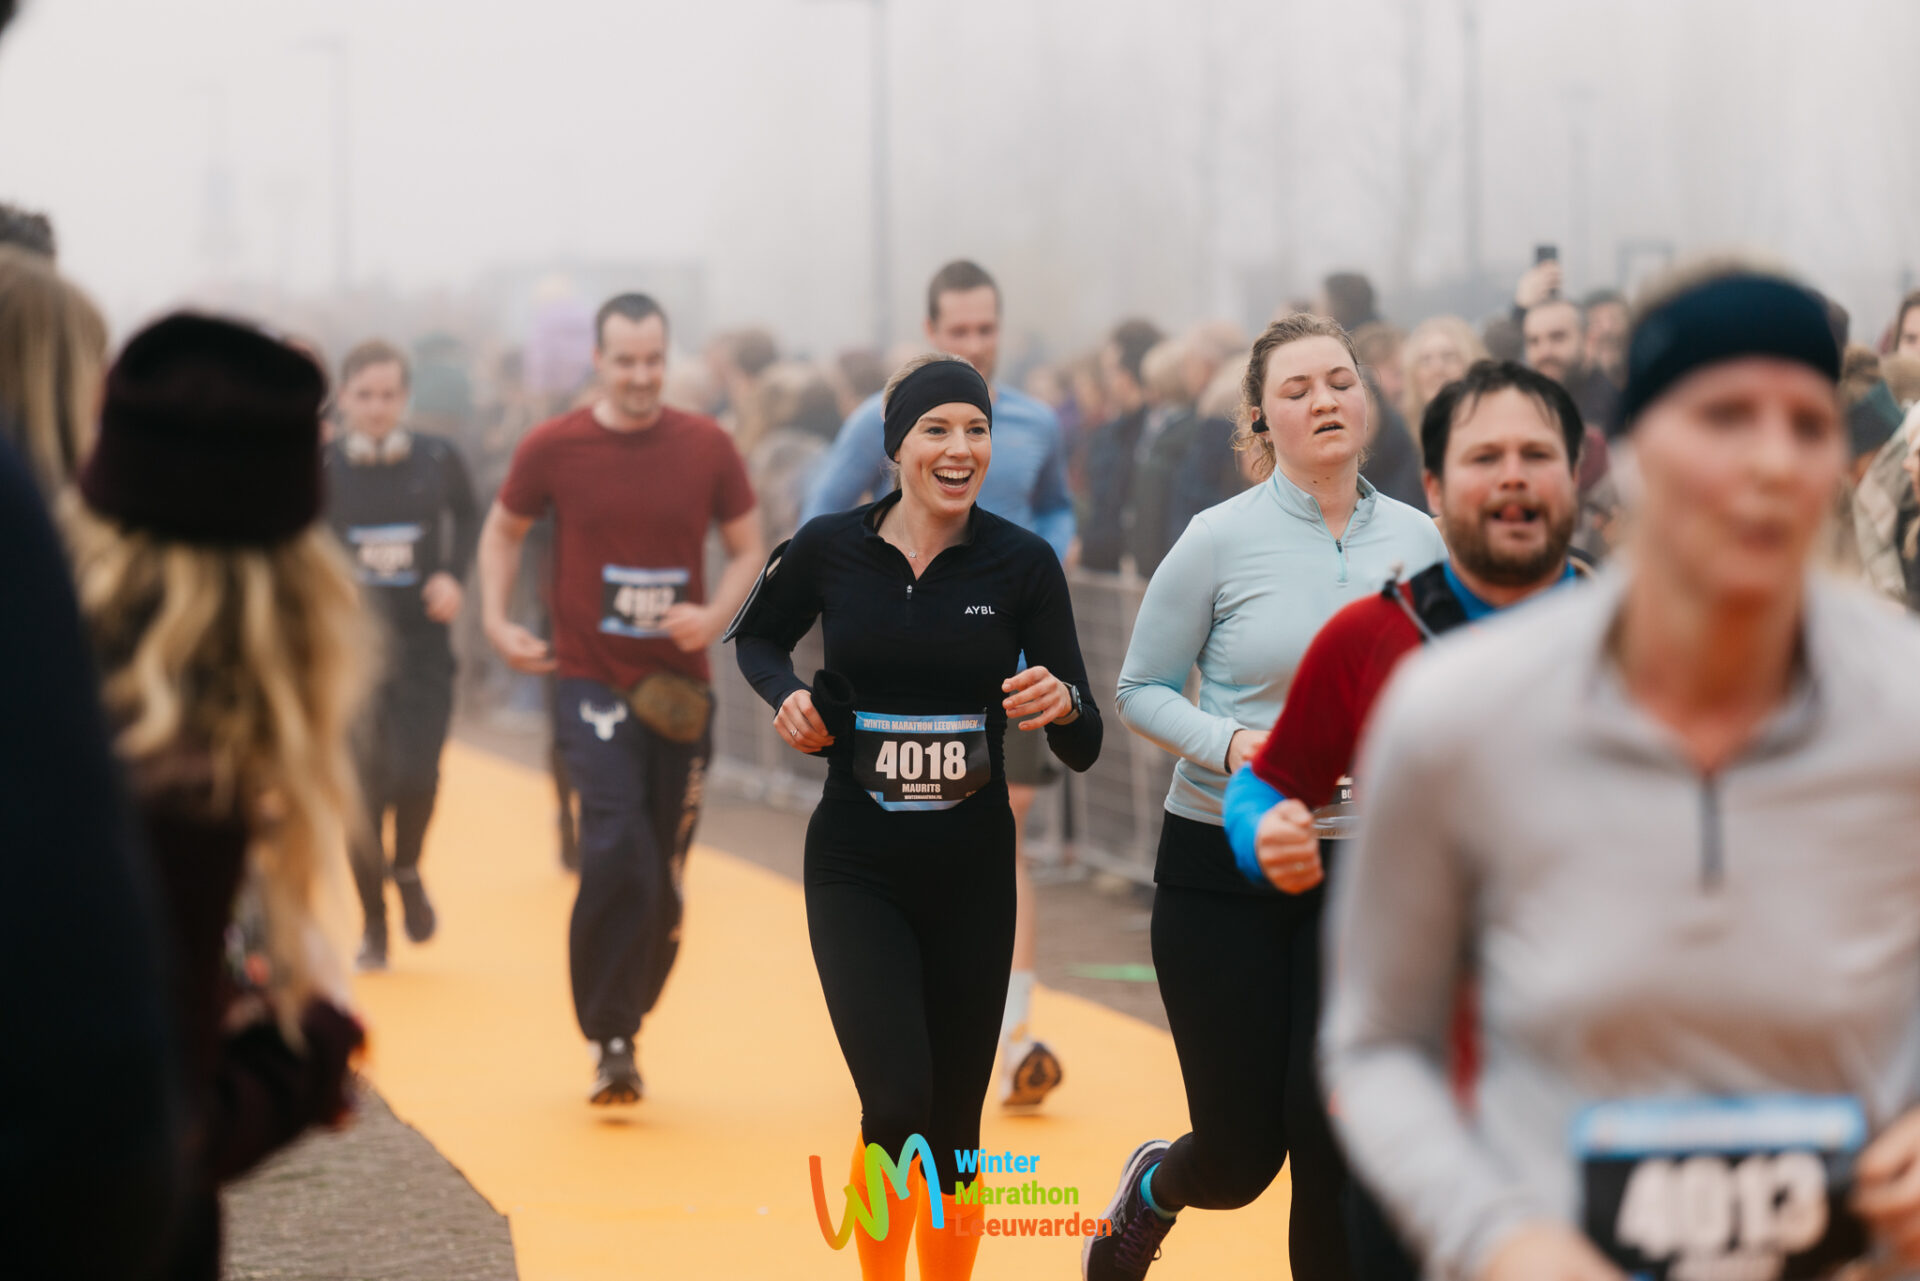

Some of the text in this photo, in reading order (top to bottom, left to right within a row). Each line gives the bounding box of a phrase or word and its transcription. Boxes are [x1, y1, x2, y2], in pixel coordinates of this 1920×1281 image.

[964, 605, 995, 615] AYBL
[863, 719, 979, 731] WINTER MARATHON LEEUWARDEN
[875, 740, 967, 780] 4018
[902, 783, 941, 793] MAURITS
[1615, 1154, 1828, 1258] 4013
